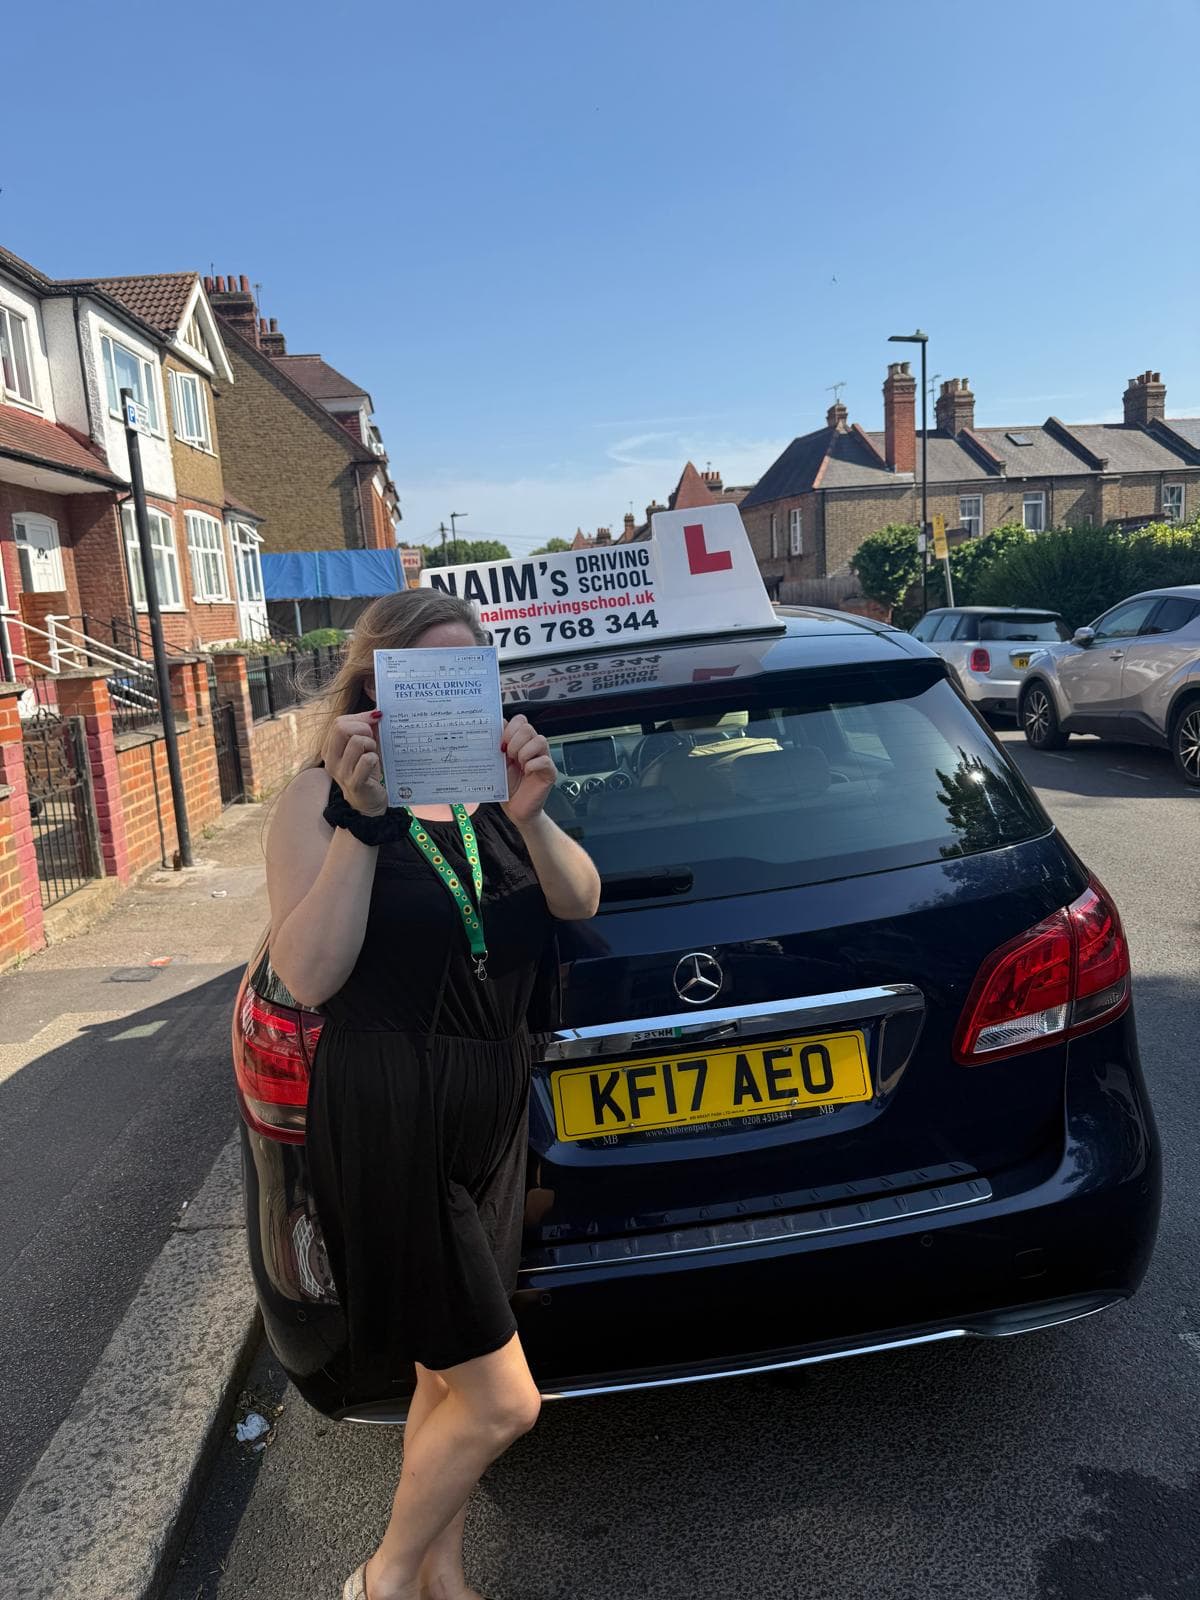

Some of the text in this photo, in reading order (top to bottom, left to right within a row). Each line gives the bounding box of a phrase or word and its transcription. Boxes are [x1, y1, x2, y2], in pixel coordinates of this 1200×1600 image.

[576, 548, 649, 574] DRIVING
[683, 524, 733, 575] L
[430, 561, 569, 606] NAIM's
[579, 569, 654, 594] SCHOOL
[480, 590, 655, 623] naimsdrivingschool.uk
[540, 618, 595, 643] 768
[605, 609, 659, 635] 344
[394, 680, 482, 691] PRACTICAL DRIVING
[395, 690, 413, 698] TEST
[434, 688, 482, 696] CERTIFICATE
[589, 1043, 835, 1126] KF17 AEO
[819, 1104, 835, 1116] MB
[602, 1134, 619, 1146] MB
